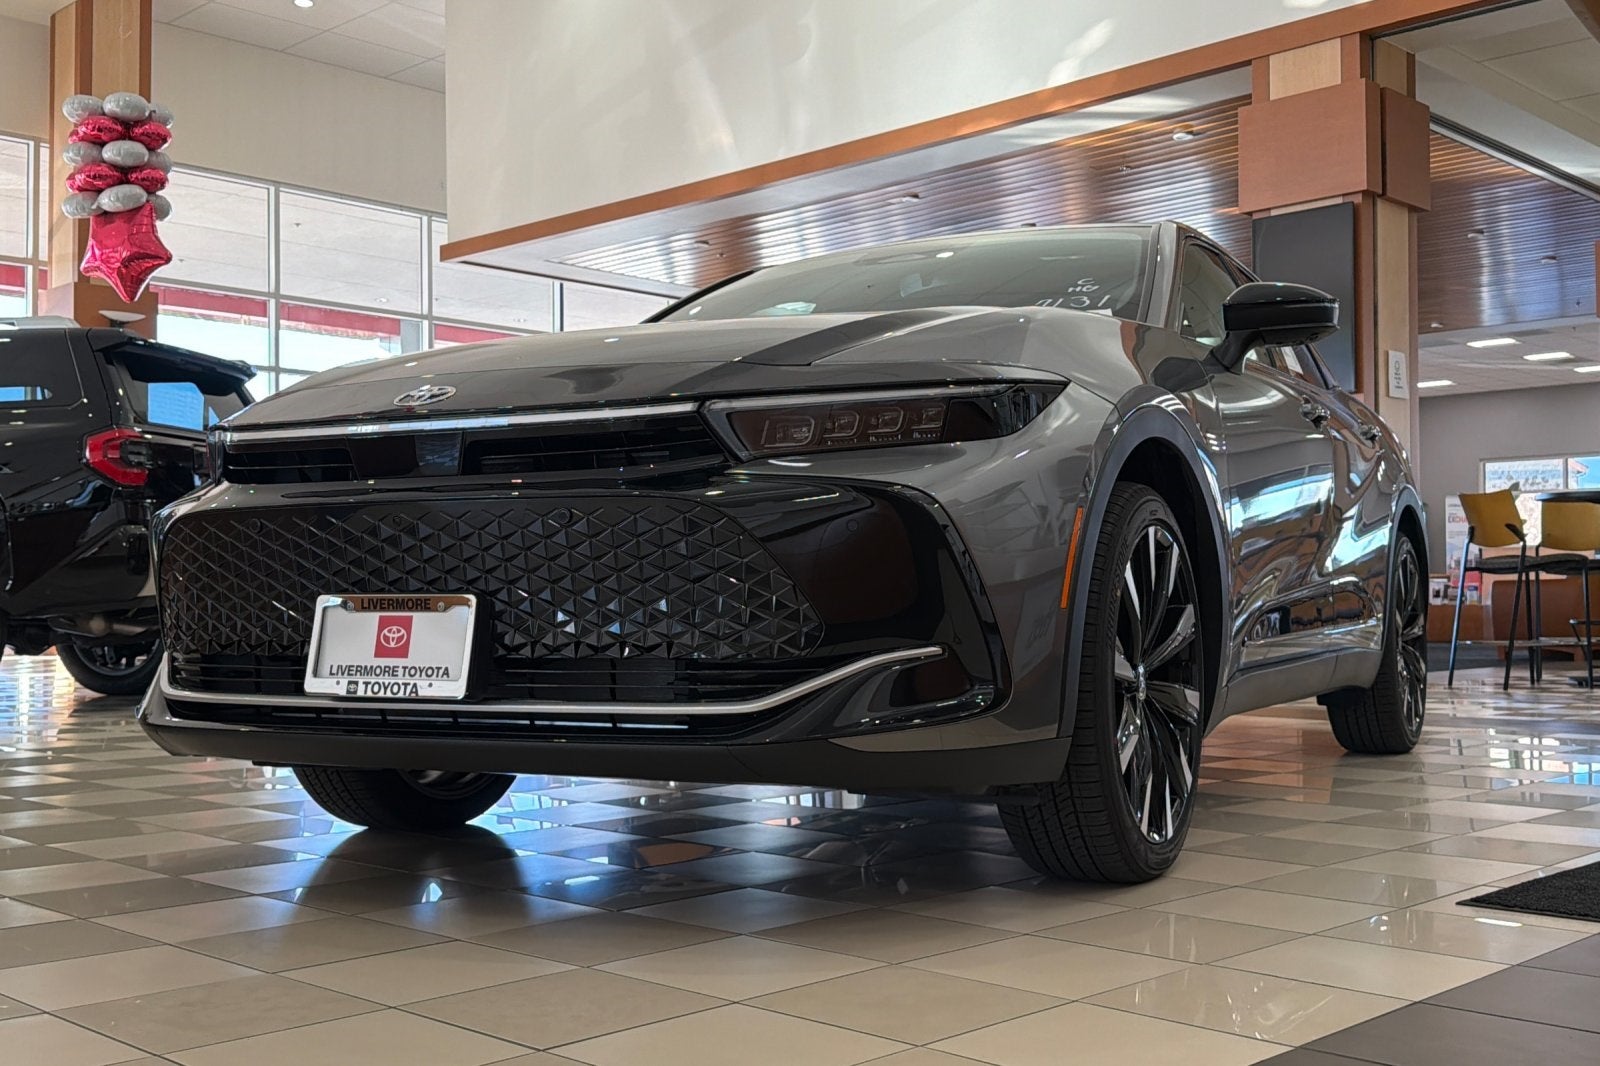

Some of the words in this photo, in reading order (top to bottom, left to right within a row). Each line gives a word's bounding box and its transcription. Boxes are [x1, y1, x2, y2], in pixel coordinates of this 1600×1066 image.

[361, 598, 431, 611] LIVERMORE
[329, 664, 399, 678] LIVERMORE
[401, 666, 450, 679] TOYOTA
[362, 681, 419, 697] TOYOTA
